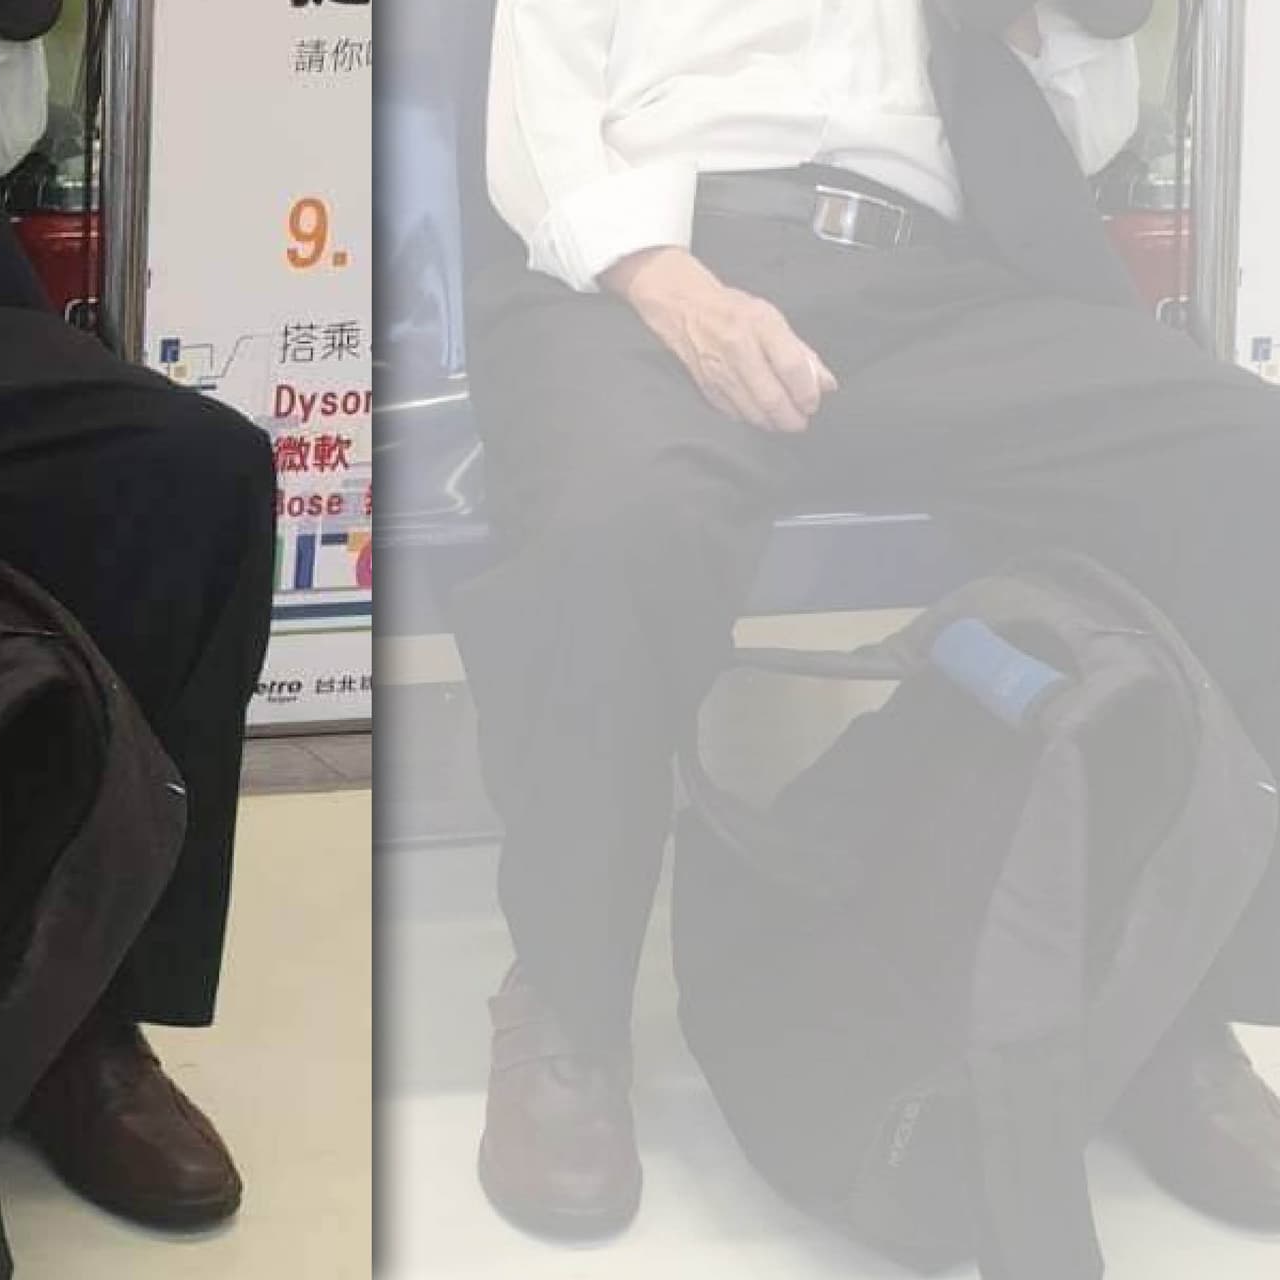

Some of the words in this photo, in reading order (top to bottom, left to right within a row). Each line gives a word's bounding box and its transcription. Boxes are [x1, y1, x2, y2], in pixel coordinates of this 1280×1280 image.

[295, 37, 372, 72] 請你
[287, 198, 347, 269] 9.
[273, 434, 351, 472] 微軟
